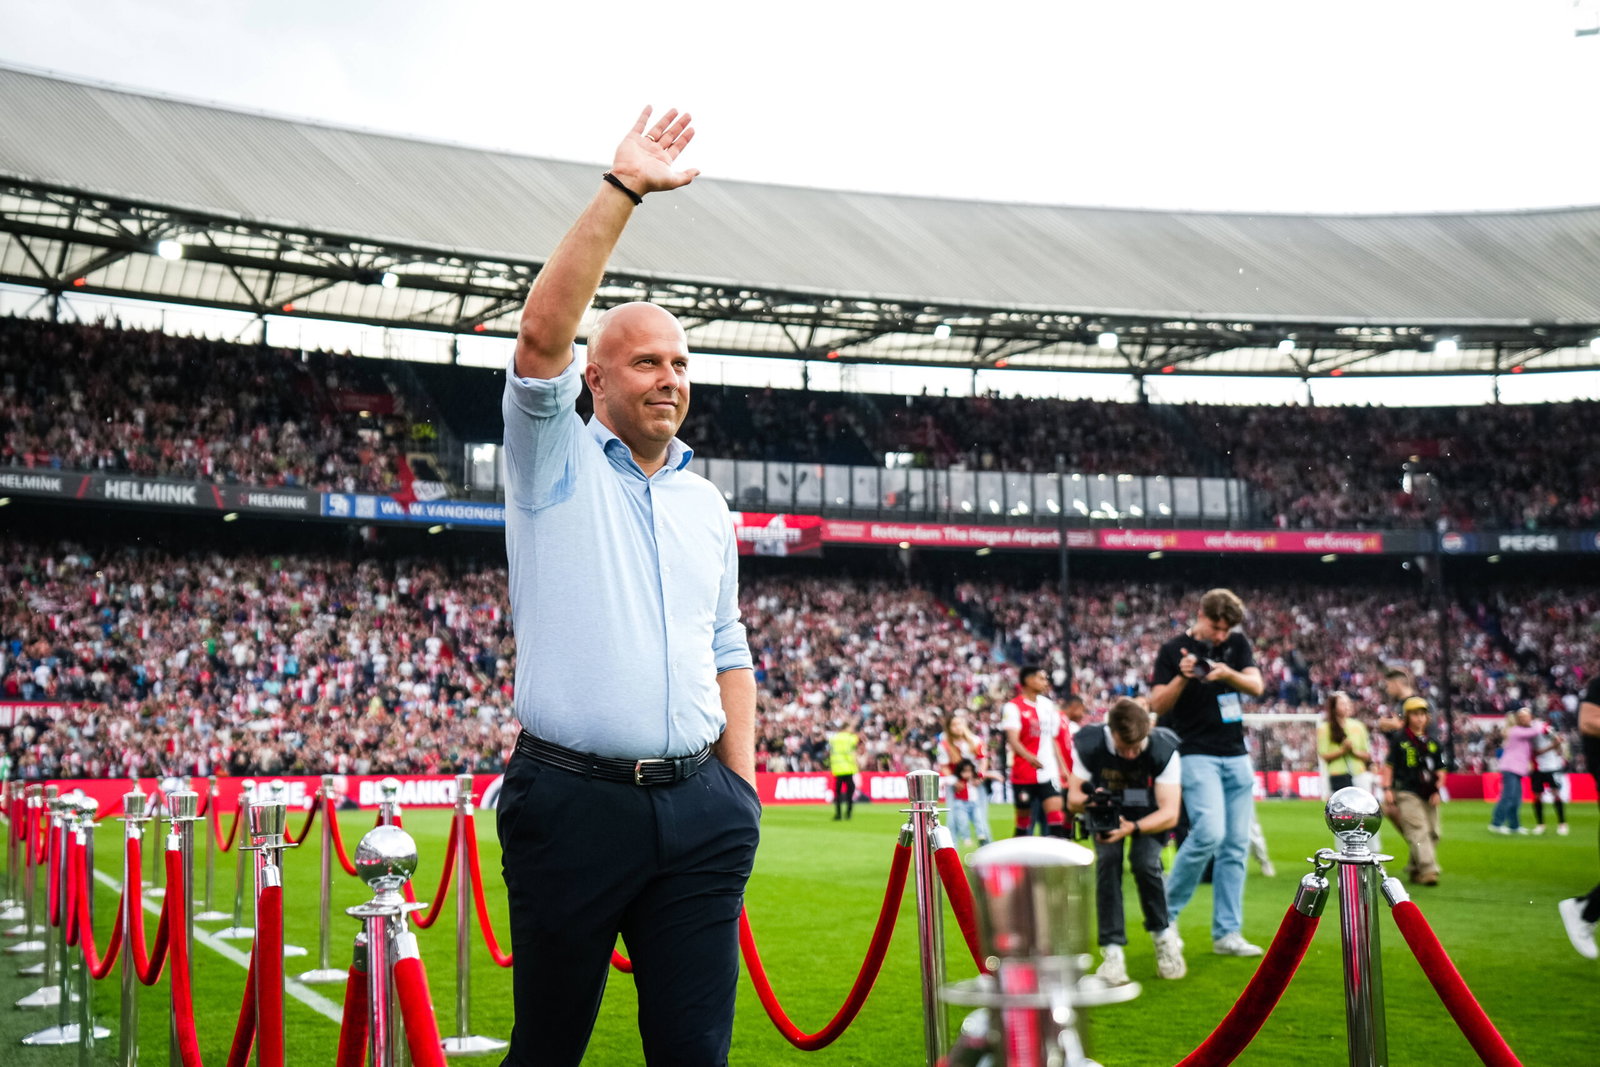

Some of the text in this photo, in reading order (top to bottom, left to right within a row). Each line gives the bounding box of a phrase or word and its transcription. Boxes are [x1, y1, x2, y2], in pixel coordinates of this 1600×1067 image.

[104, 480, 196, 505] HELMINK
[247, 493, 307, 510] HELMINK
[871, 525, 940, 541] Rotterdam
[943, 526, 967, 542] The
[970, 528, 1010, 546] Hague
[1012, 529, 1060, 547] Airport
[1499, 534, 1557, 551] PEPSI
[774, 777, 834, 803] ARNE,
